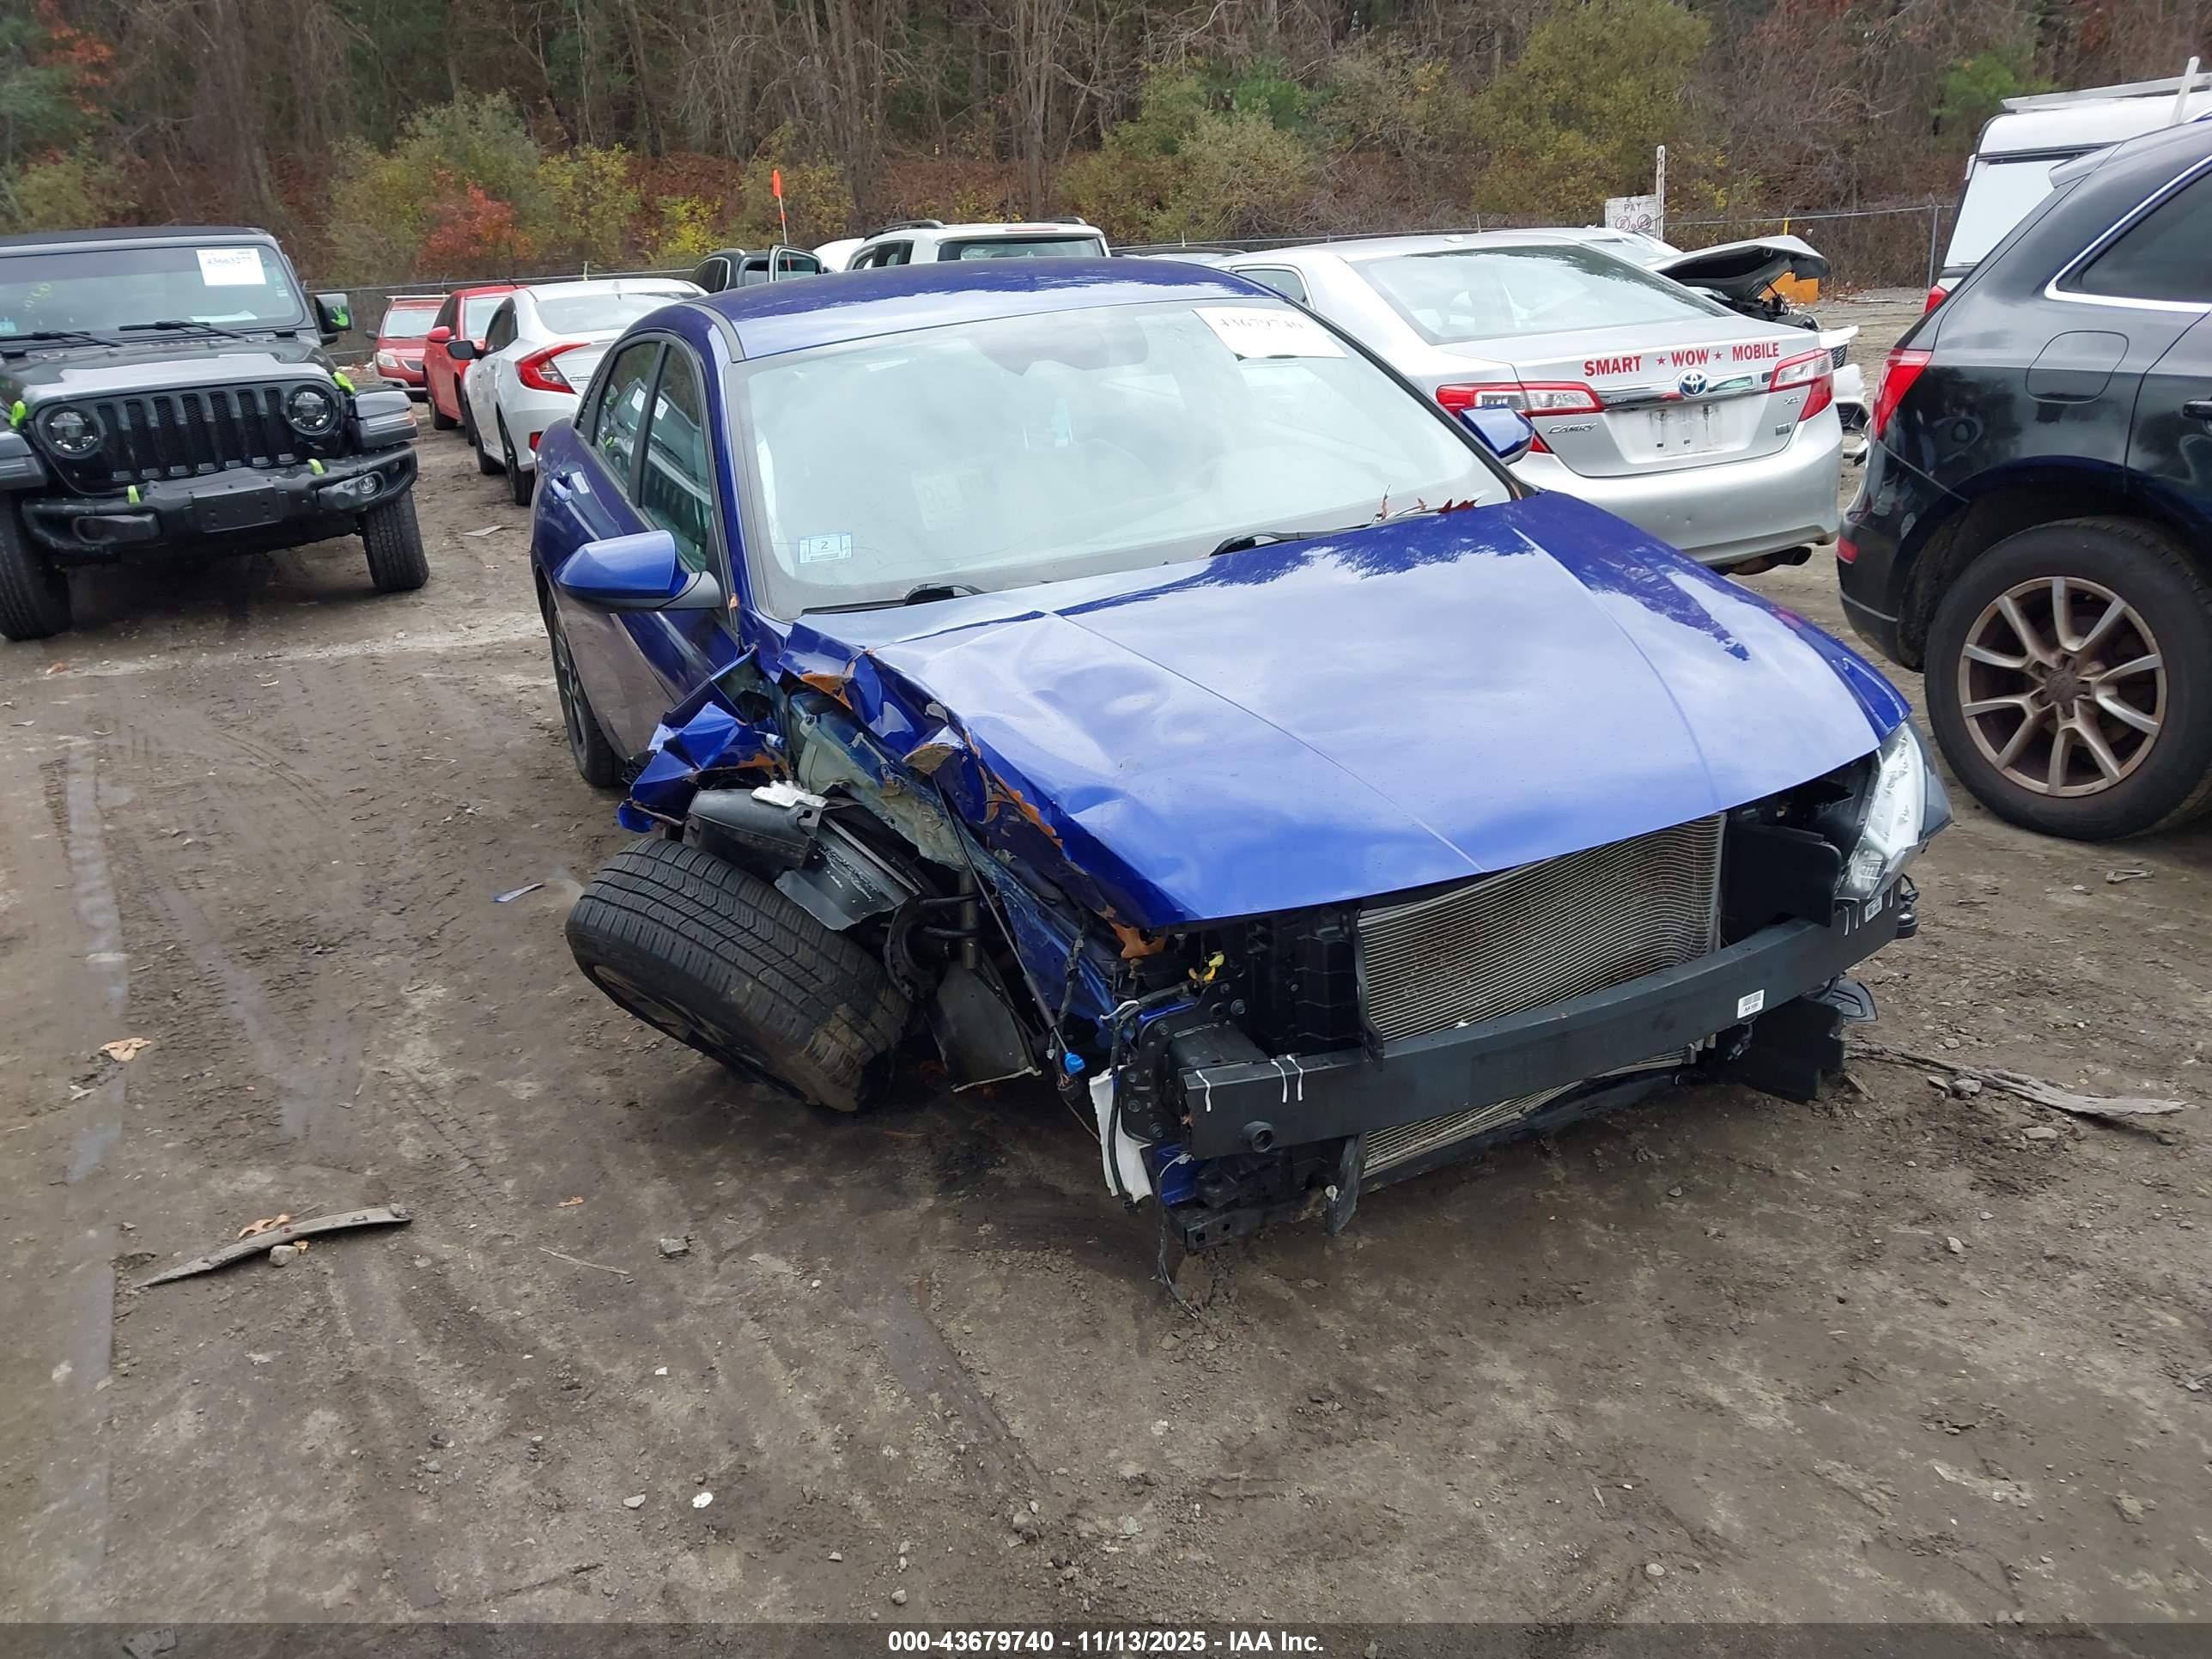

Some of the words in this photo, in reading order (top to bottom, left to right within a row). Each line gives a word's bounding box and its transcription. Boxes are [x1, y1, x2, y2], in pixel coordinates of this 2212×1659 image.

[1623, 203, 1642, 212] PAY
[1583, 356, 1642, 377] SMART
[1671, 349, 1710, 368] WOW
[1732, 343, 1780, 362] MOBILE
[821, 541, 829, 550] 2
